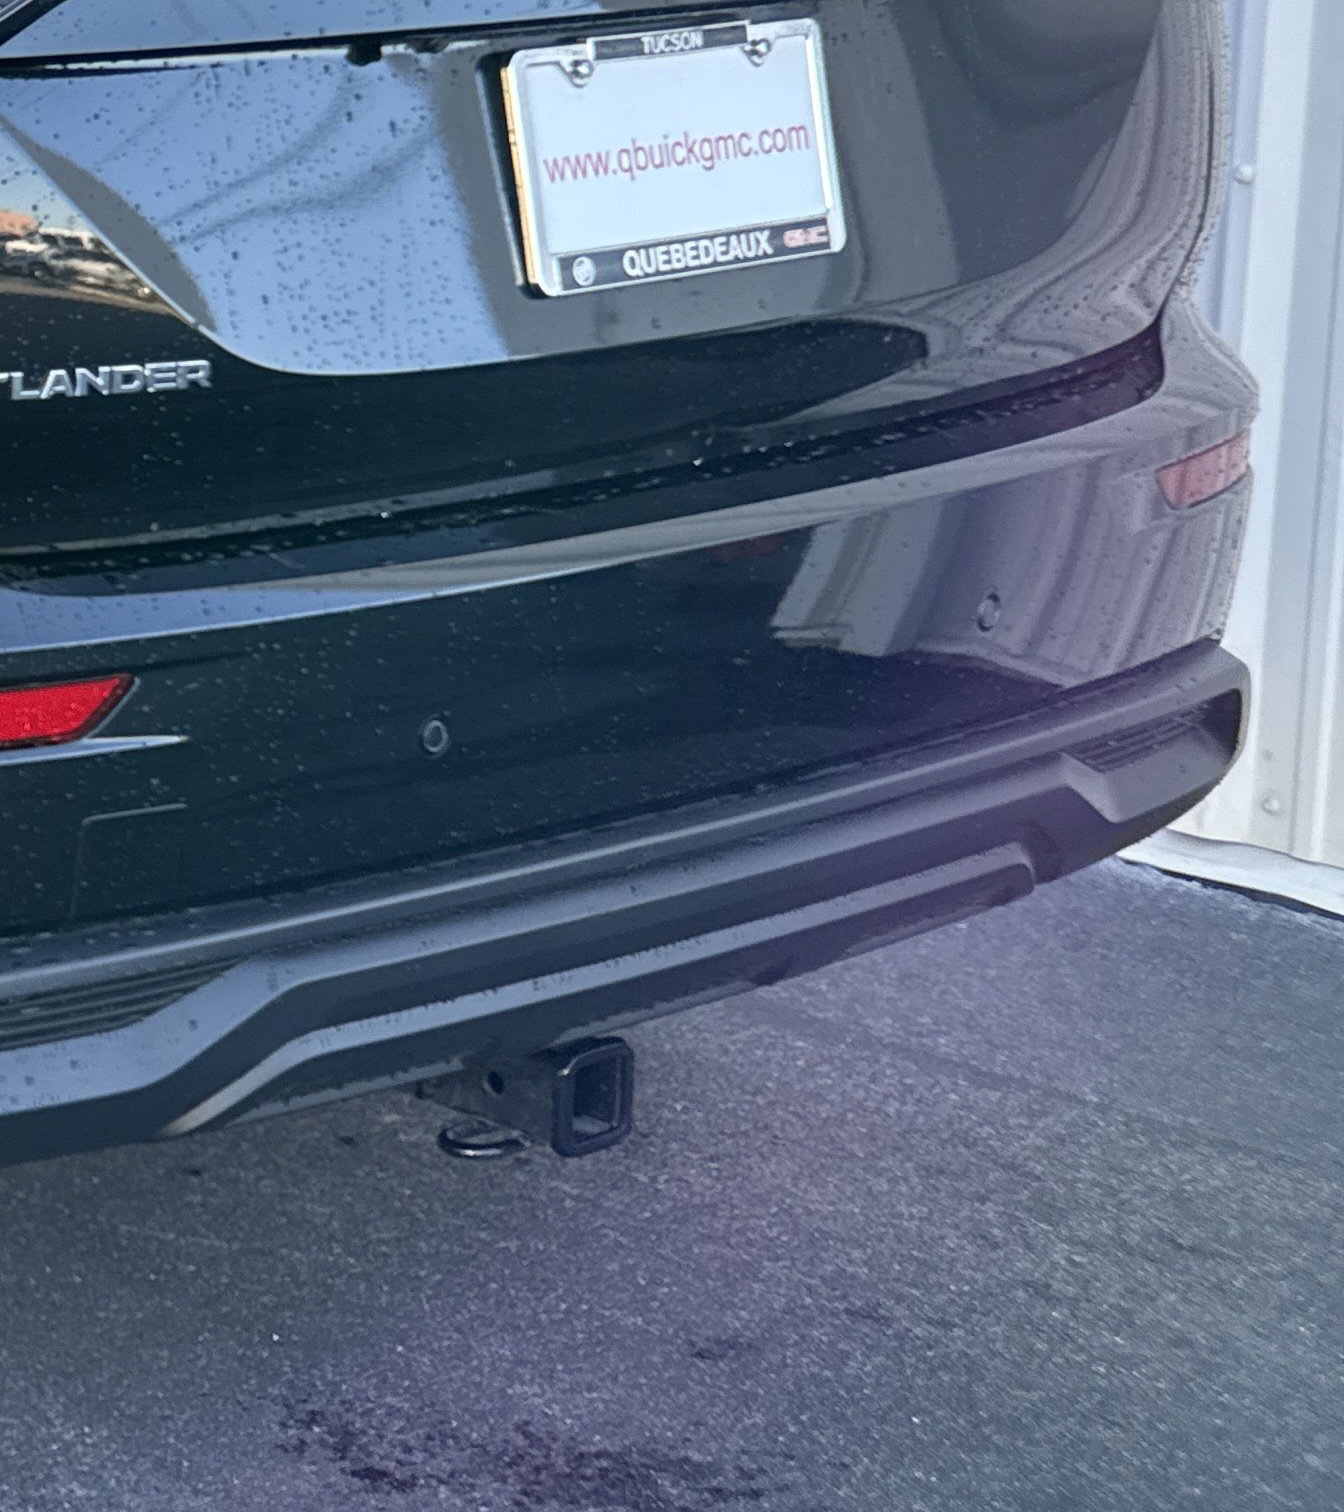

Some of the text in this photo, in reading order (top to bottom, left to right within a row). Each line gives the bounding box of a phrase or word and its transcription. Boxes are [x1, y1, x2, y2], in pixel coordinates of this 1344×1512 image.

[640, 30, 704, 55] TUCSON
[543, 123, 809, 183] www.qbuickgmc.com
[622, 229, 774, 278] QUEBEDEAUX
